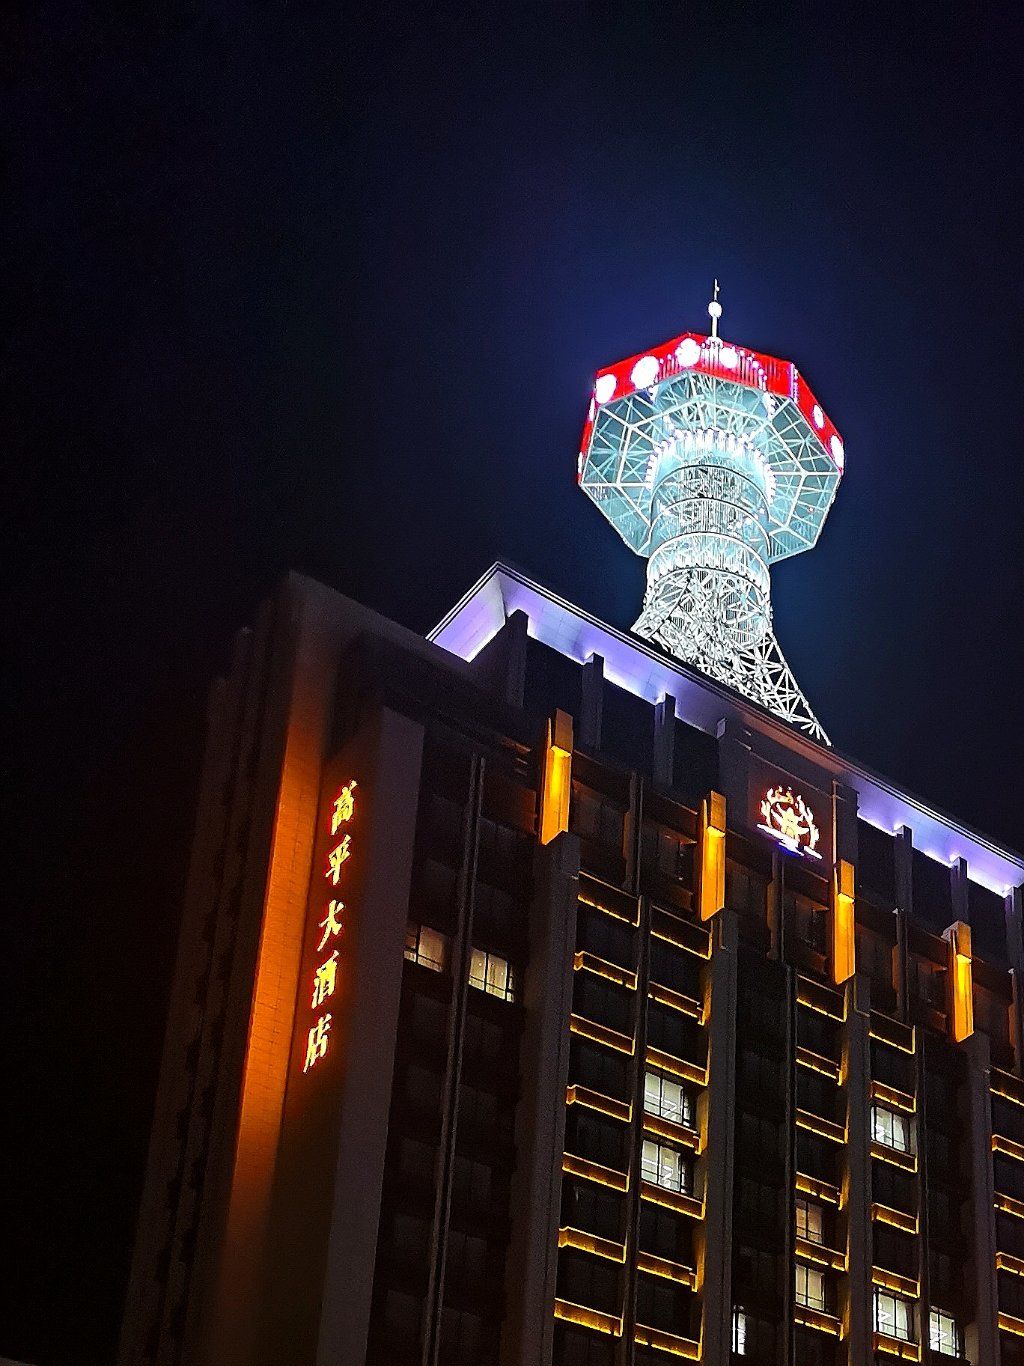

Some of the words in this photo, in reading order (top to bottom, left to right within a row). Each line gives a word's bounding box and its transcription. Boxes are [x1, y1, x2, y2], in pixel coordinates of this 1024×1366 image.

[302, 780, 357, 1074] 高平大酒店
